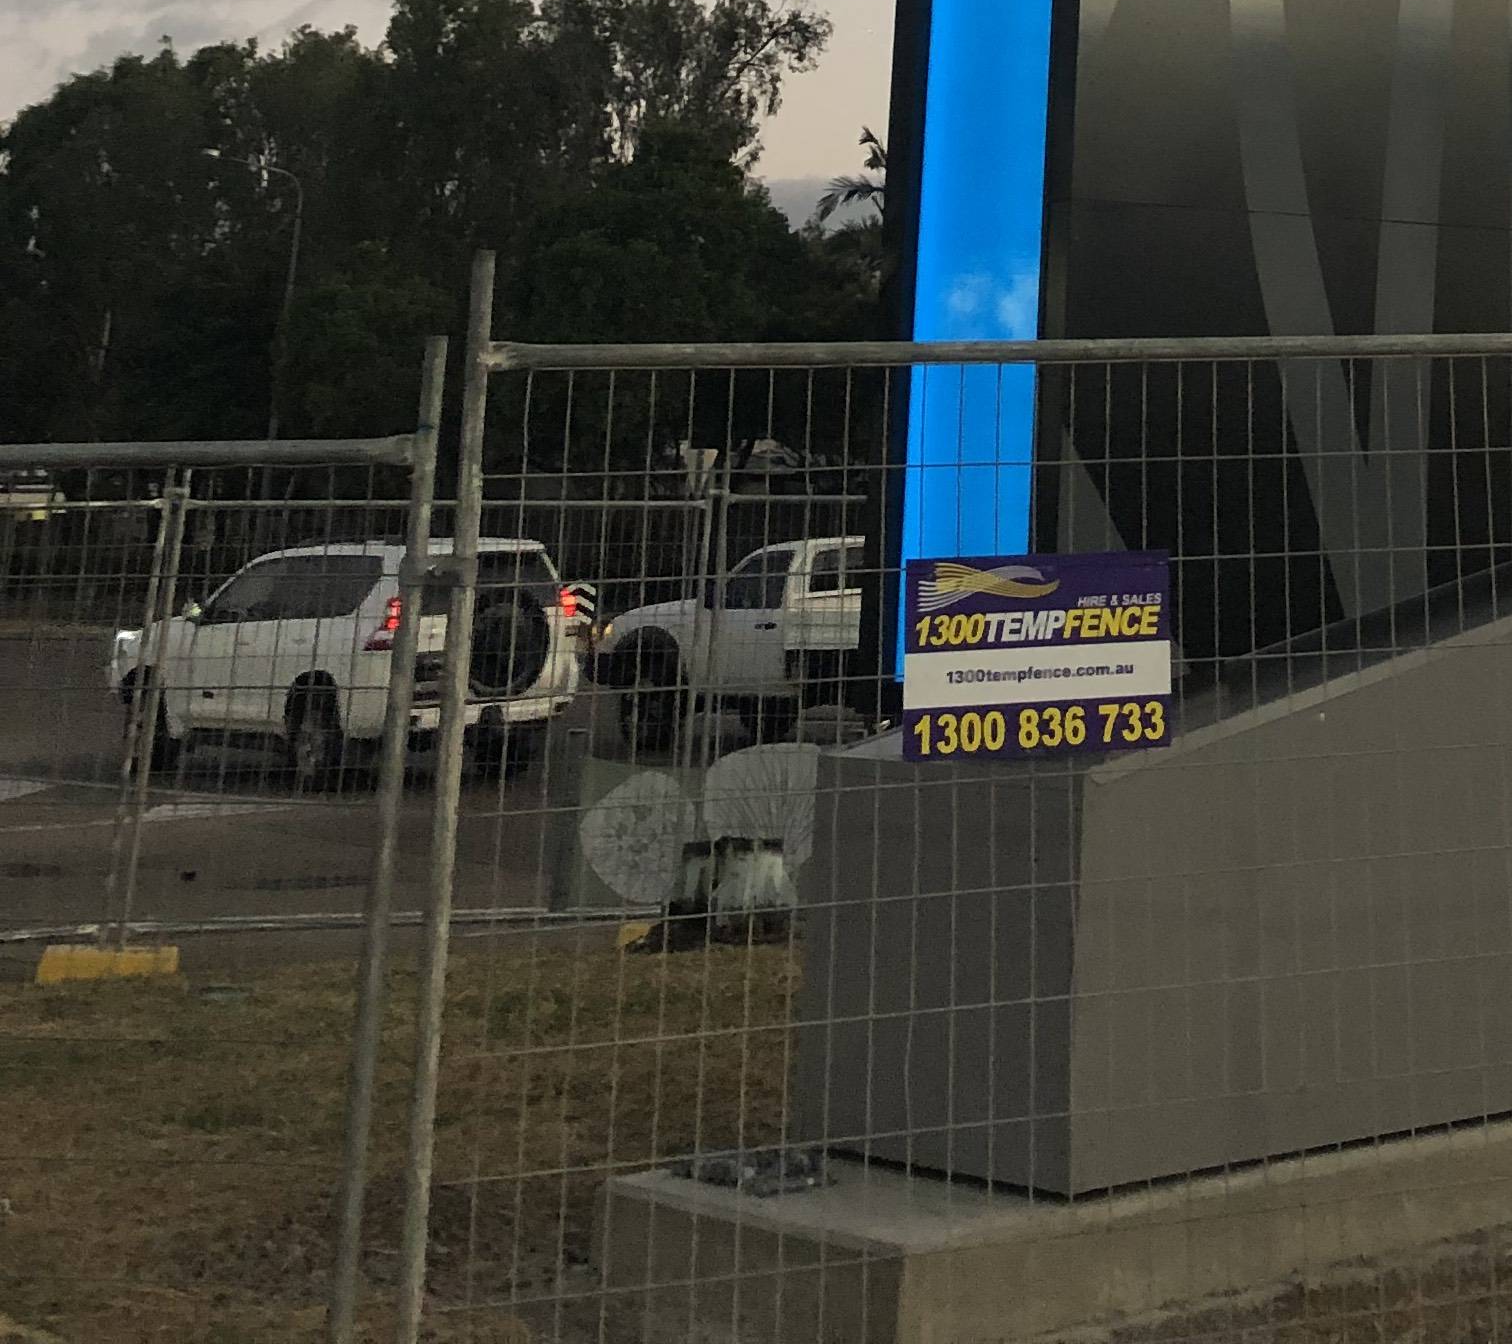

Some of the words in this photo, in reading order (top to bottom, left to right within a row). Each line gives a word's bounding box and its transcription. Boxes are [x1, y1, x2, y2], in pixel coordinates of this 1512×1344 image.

[1077, 595, 1107, 607] HIRE
[1110, 594, 1119, 606] &
[1122, 593, 1162, 605] SALES
[915, 605, 1161, 646] 1300TEMPFENCE
[946, 663, 1135, 684] 1300tempfence.com.au
[913, 710, 1006, 756] 1300
[1018, 705, 1086, 748] 836
[1098, 700, 1166, 744] 733
